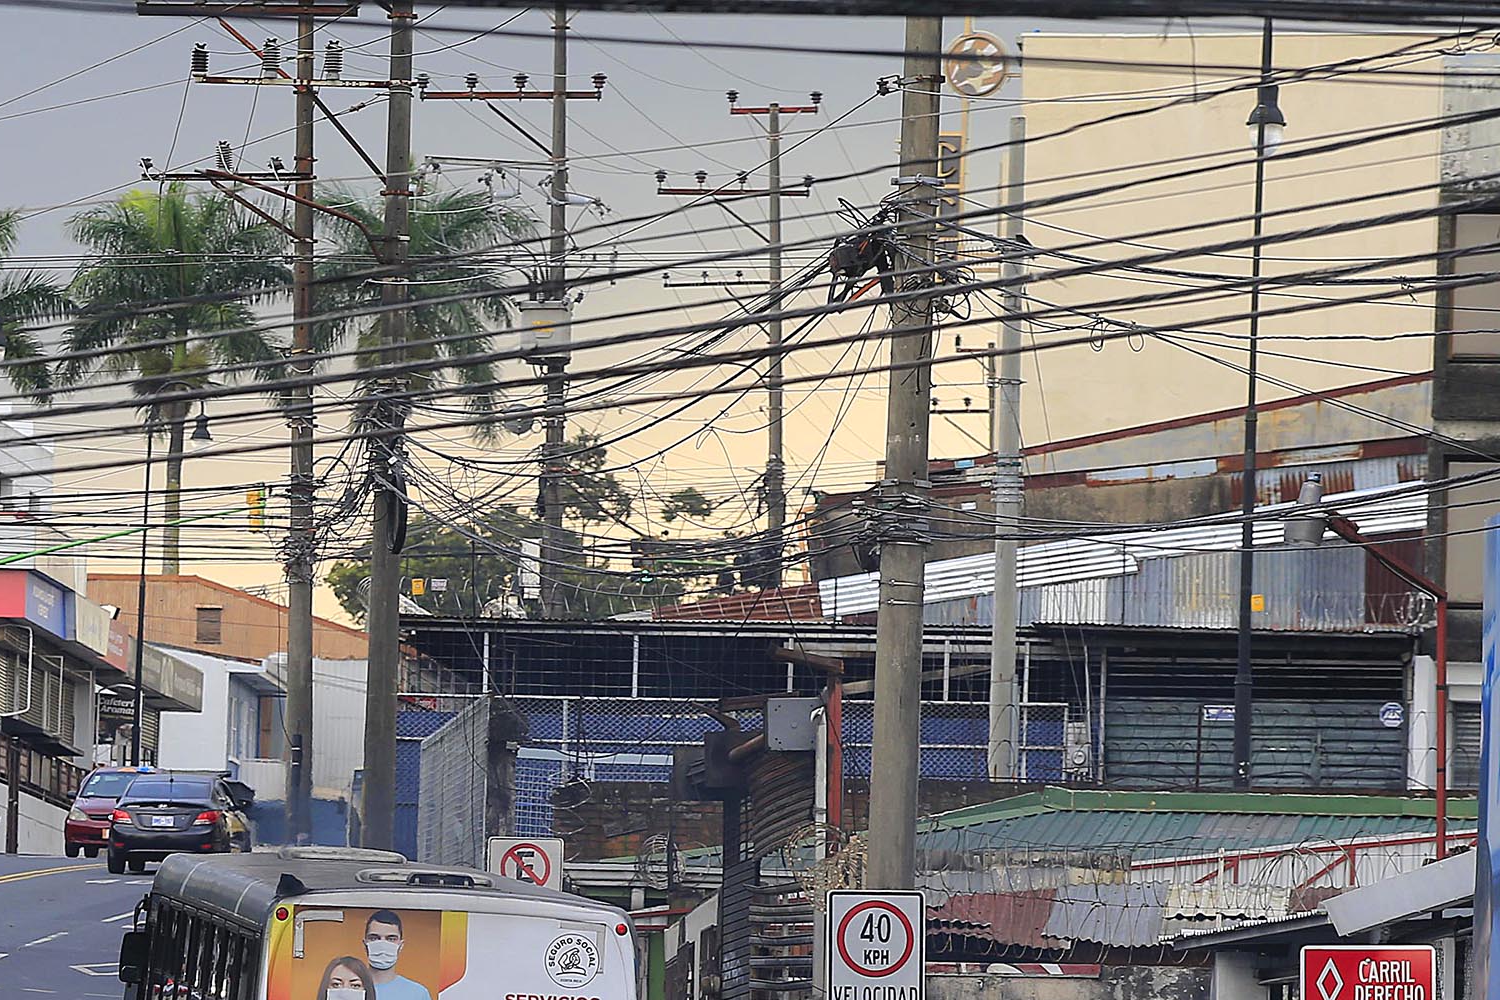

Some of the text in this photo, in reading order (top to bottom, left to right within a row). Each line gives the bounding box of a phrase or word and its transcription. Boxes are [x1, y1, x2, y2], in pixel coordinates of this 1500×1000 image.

[100, 697, 135, 707] Cafeterí
[860, 913, 891, 943] 40
[548, 937, 596, 968] SEGURO SOCIAL
[863, 950, 890, 965] KPH
[1358, 960, 1415, 983] CARRIL
